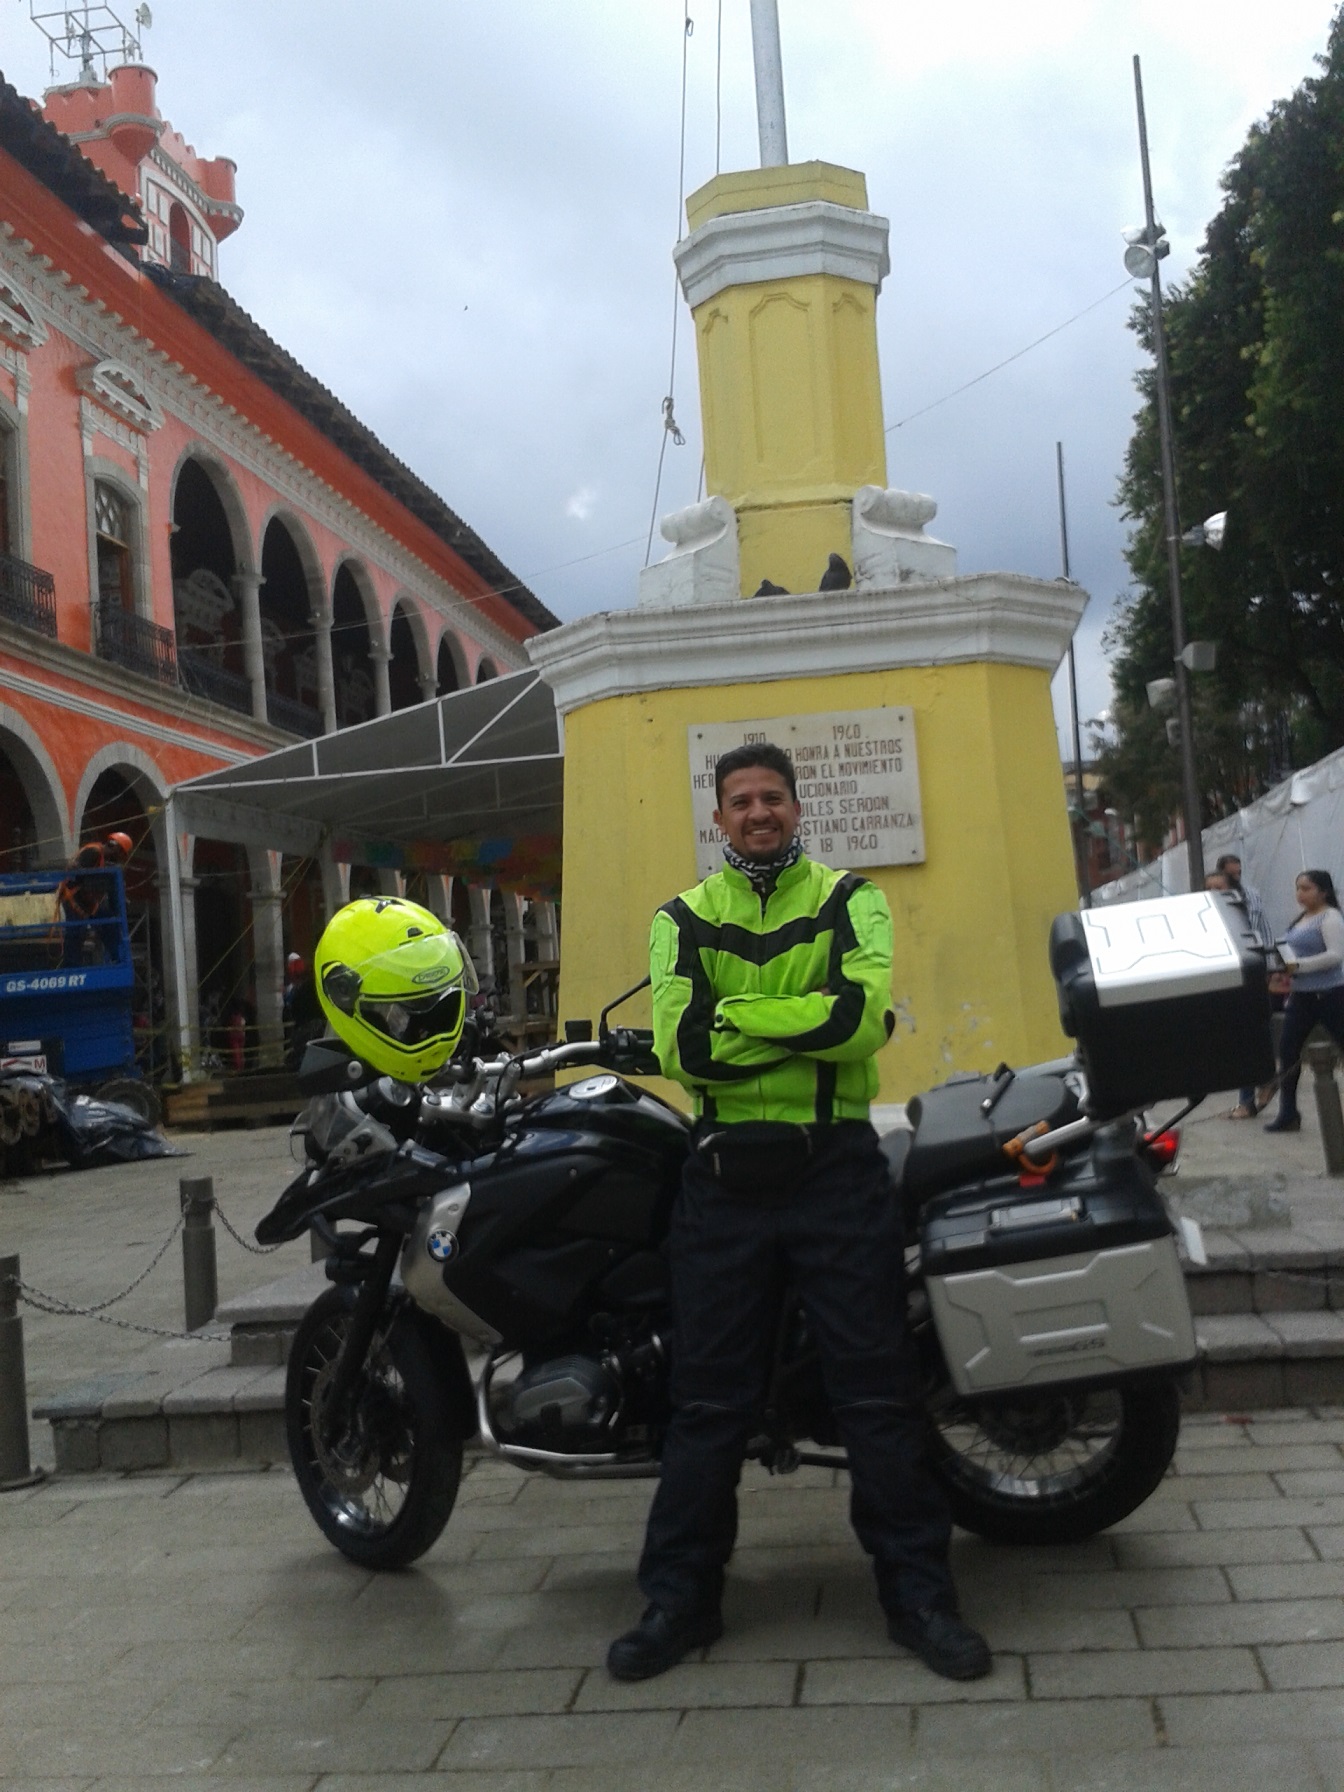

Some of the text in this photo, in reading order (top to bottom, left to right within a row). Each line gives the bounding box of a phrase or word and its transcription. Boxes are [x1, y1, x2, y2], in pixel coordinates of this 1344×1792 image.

[743, 732, 766, 746] 1910
[794, 744, 829, 762] HONRA
[833, 743, 841, 759] A
[844, 738, 903, 759] NUESTROS
[821, 763, 835, 779] EL
[838, 757, 903, 777] MOVIMIENTO
[798, 780, 858, 799] UCIONARIO
[839, 795, 890, 815] SERDAN
[851, 813, 914, 834] CARRANZA
[820, 837, 834, 853] 18
[846, 834, 878, 852] 1960
[68, 973, 87, 988] RT
